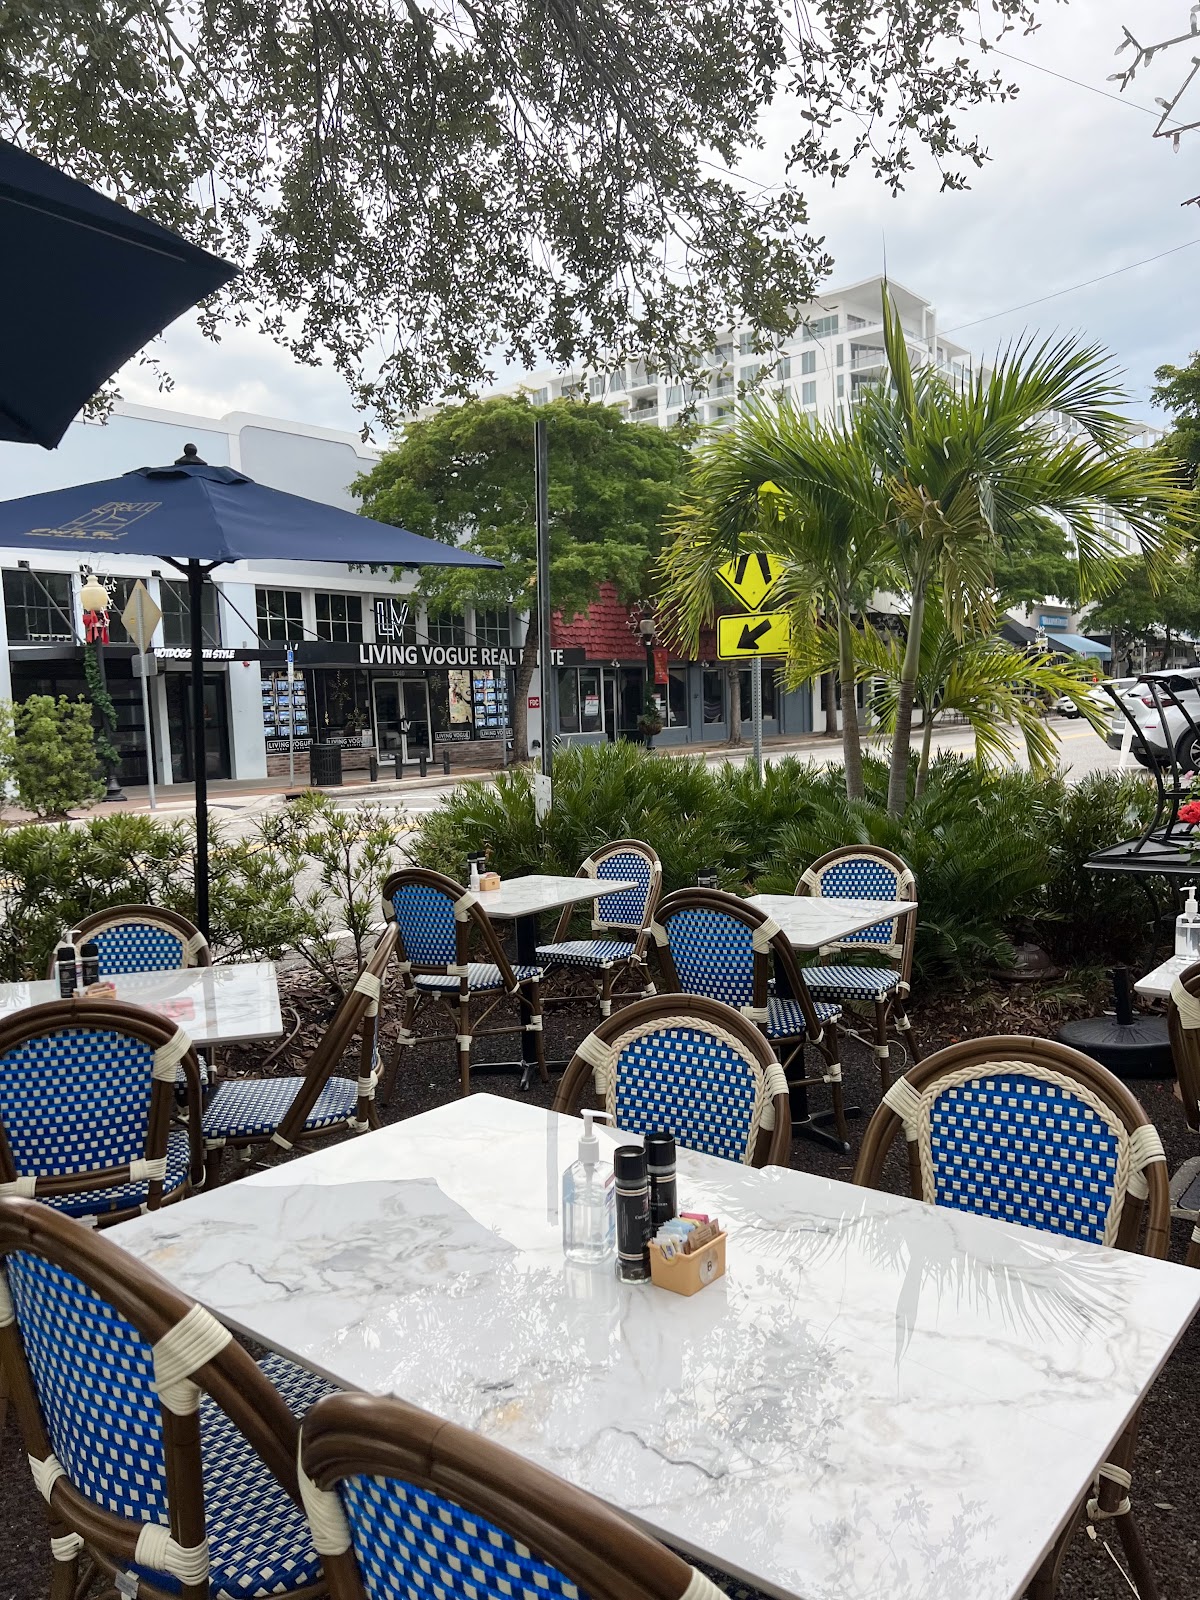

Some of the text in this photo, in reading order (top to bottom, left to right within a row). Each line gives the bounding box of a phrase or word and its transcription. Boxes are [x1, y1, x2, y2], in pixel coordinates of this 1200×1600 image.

[153, 648, 192, 659] HOTDOGS
[212, 649, 236, 659] STYLE
[359, 644, 418, 665] LIVING
[421, 646, 478, 666] VOGUE
[481, 648, 517, 666] REAL
[529, 699, 540, 707] FDC
[268, 741, 290, 749] LIVING
